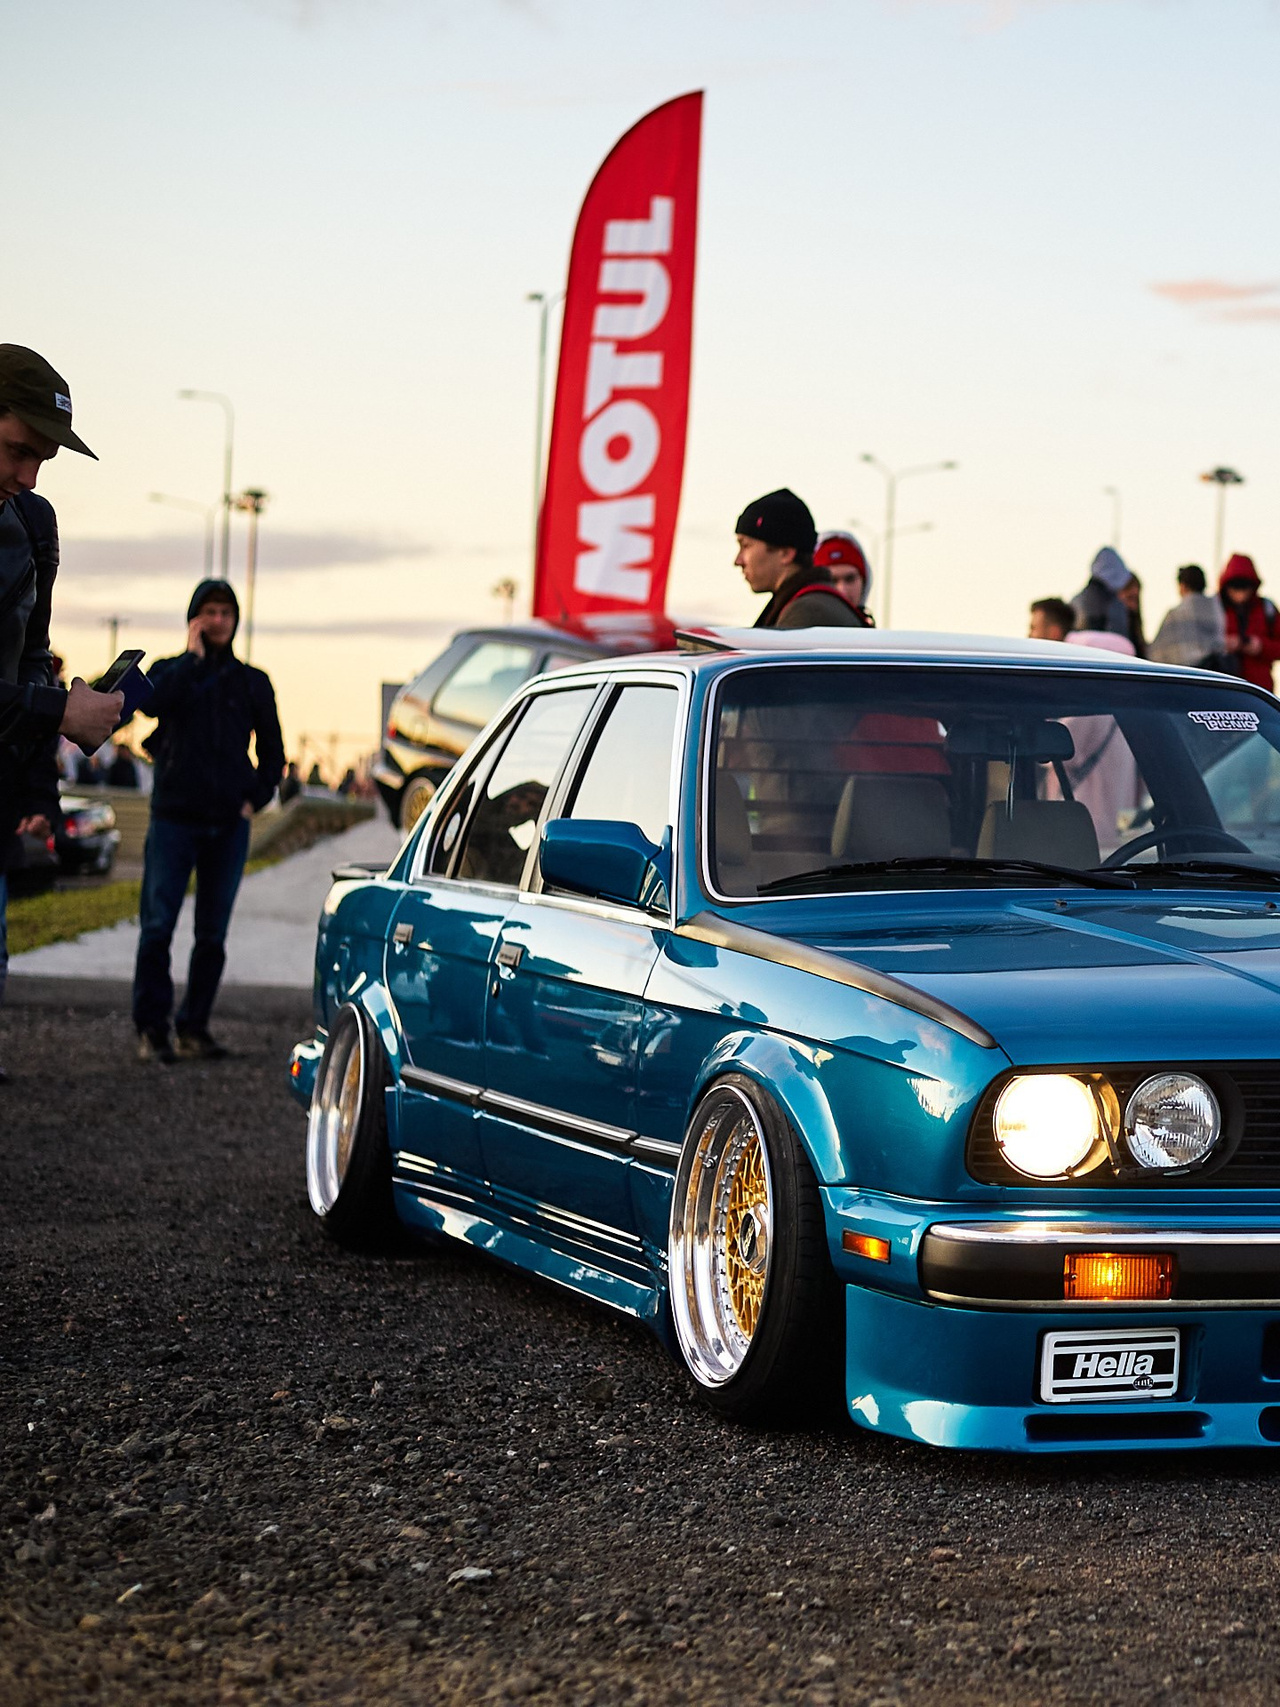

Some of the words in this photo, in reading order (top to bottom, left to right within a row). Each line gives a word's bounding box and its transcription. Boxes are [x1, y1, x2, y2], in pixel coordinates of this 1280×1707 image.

[573, 195, 675, 604] MOTUL
[1188, 712, 1258, 722] TSUNAMI
[1207, 720, 1256, 730] PICNIC
[1072, 1352, 1154, 1378] Hella
